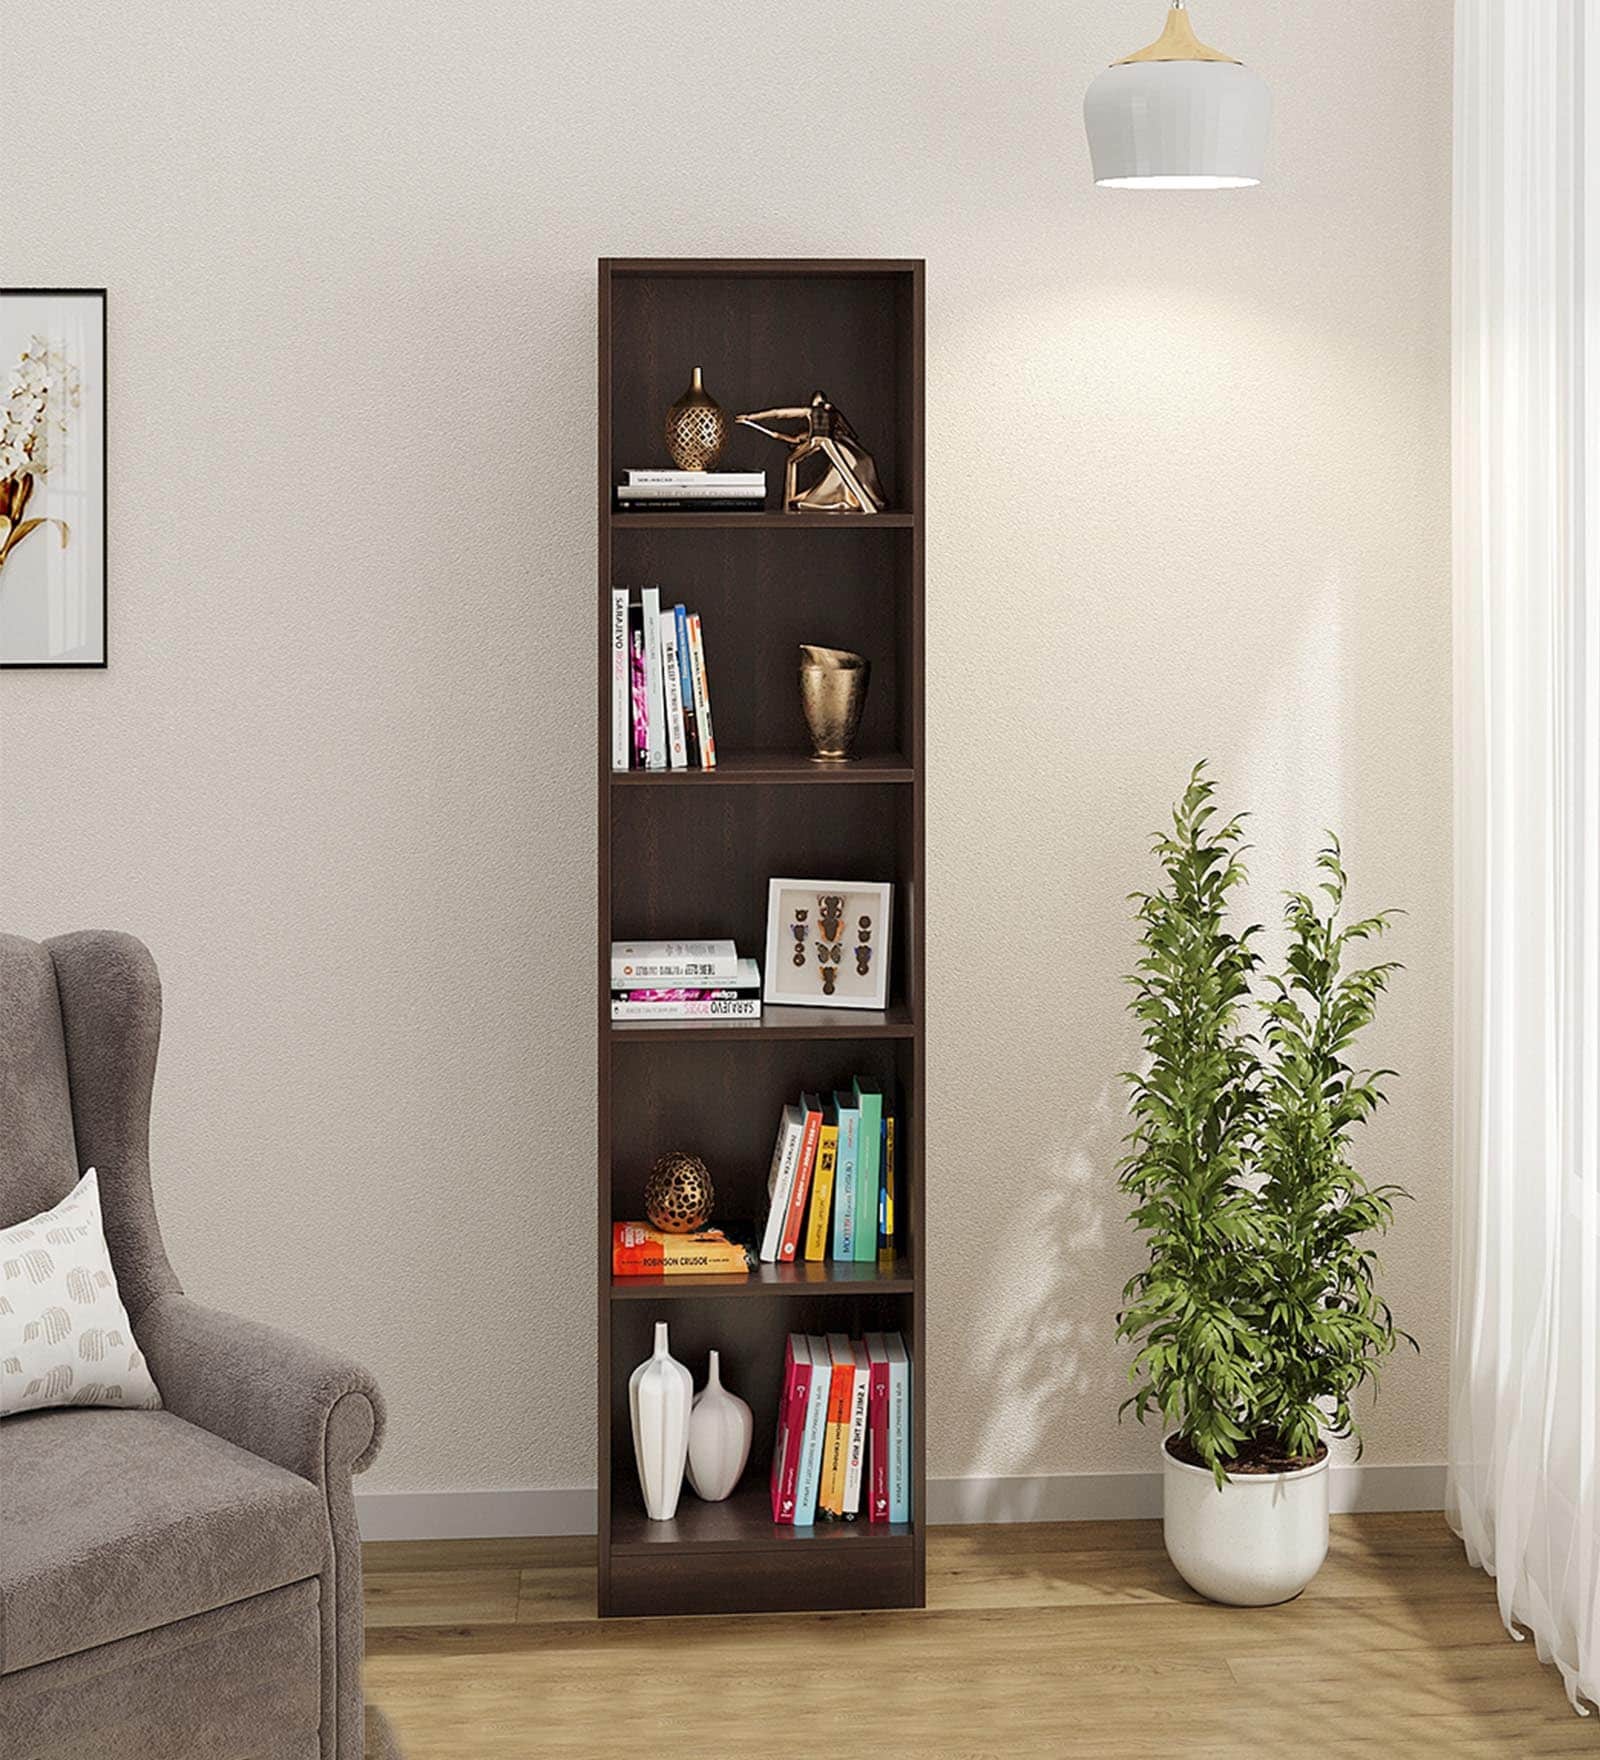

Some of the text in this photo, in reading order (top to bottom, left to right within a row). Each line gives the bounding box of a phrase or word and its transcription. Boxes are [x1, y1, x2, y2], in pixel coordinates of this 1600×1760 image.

[615, 597, 624, 649] SARAJEVO
[667, 664, 676, 681] SLEEP
[710, 1001, 755, 1014] SARAJEVO
[643, 1256, 679, 1267] ROBINSON
[680, 1256, 708, 1266] CRUSOE
